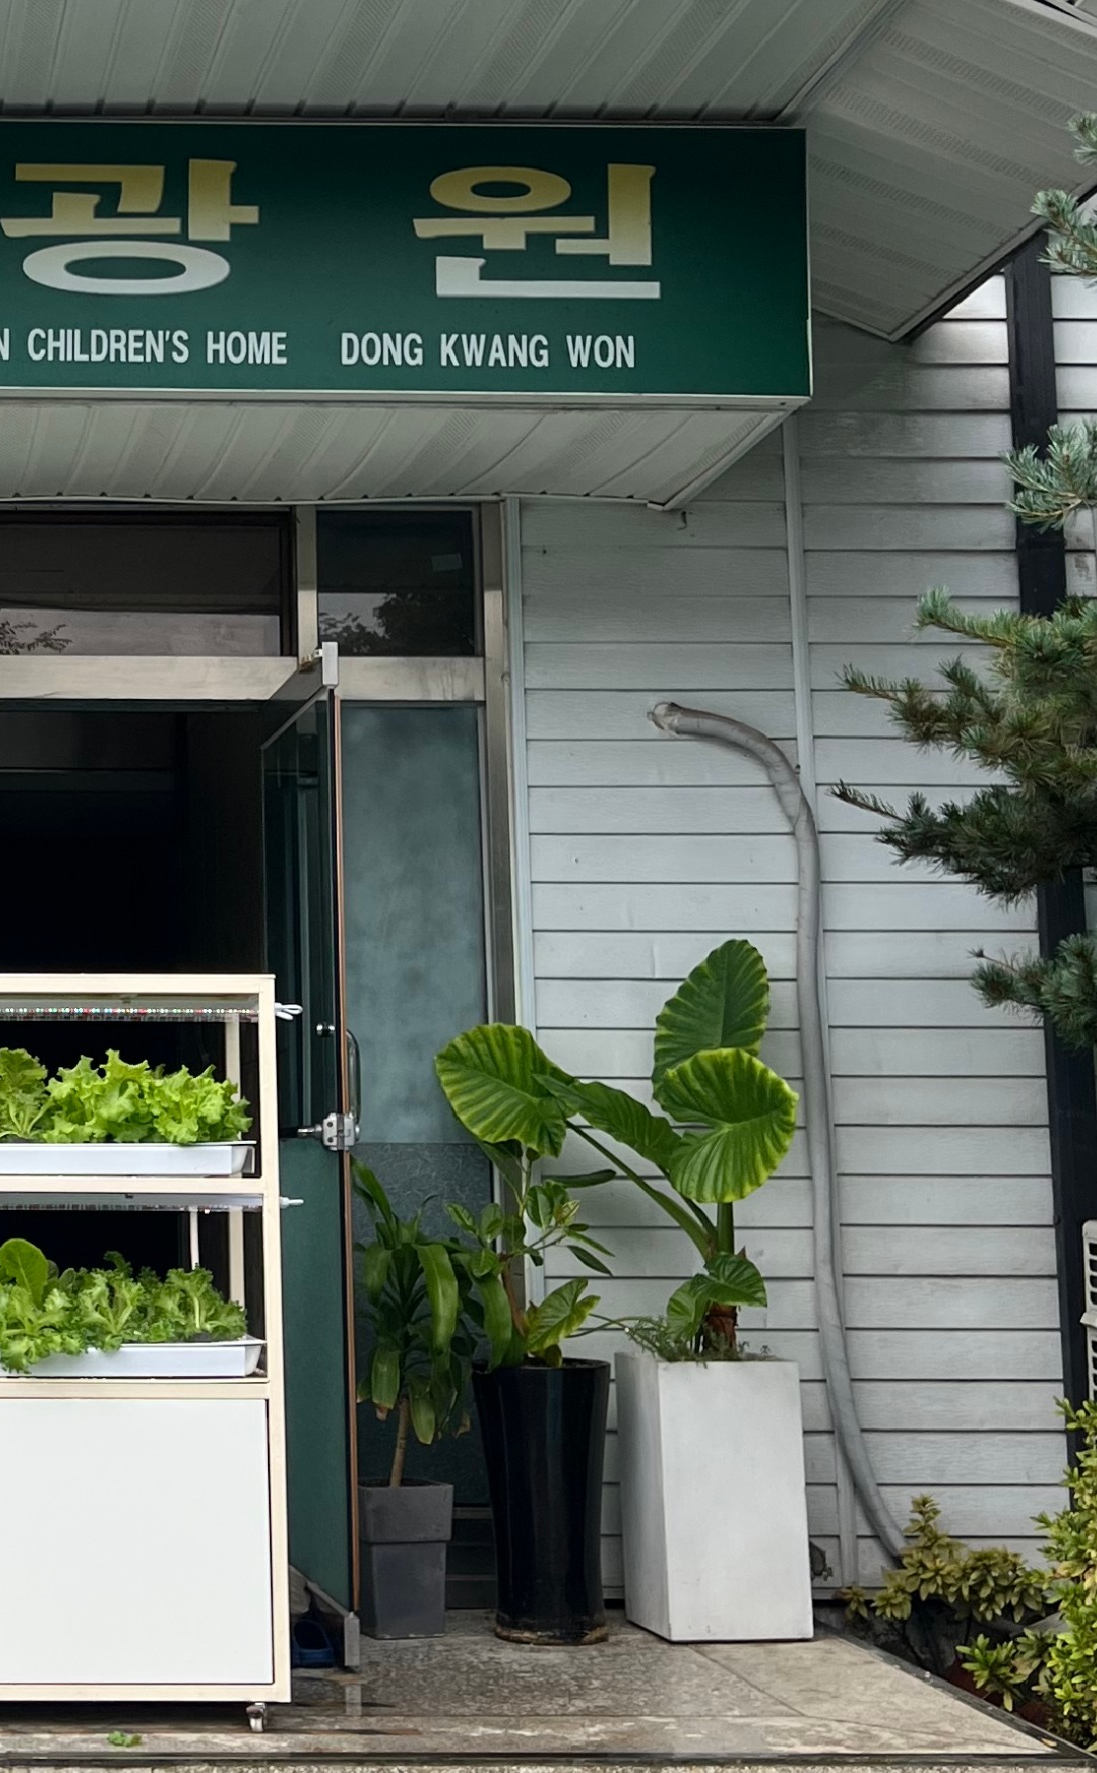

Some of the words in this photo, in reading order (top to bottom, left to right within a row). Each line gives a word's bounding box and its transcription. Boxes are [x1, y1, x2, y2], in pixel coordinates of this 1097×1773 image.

[27, 328, 189, 364] CHILDREN'S
[206, 331, 288, 365] HOME
[341, 332, 423, 366] DONG
[440, 334, 550, 368] KWANG
[566, 335, 635, 368] WON
